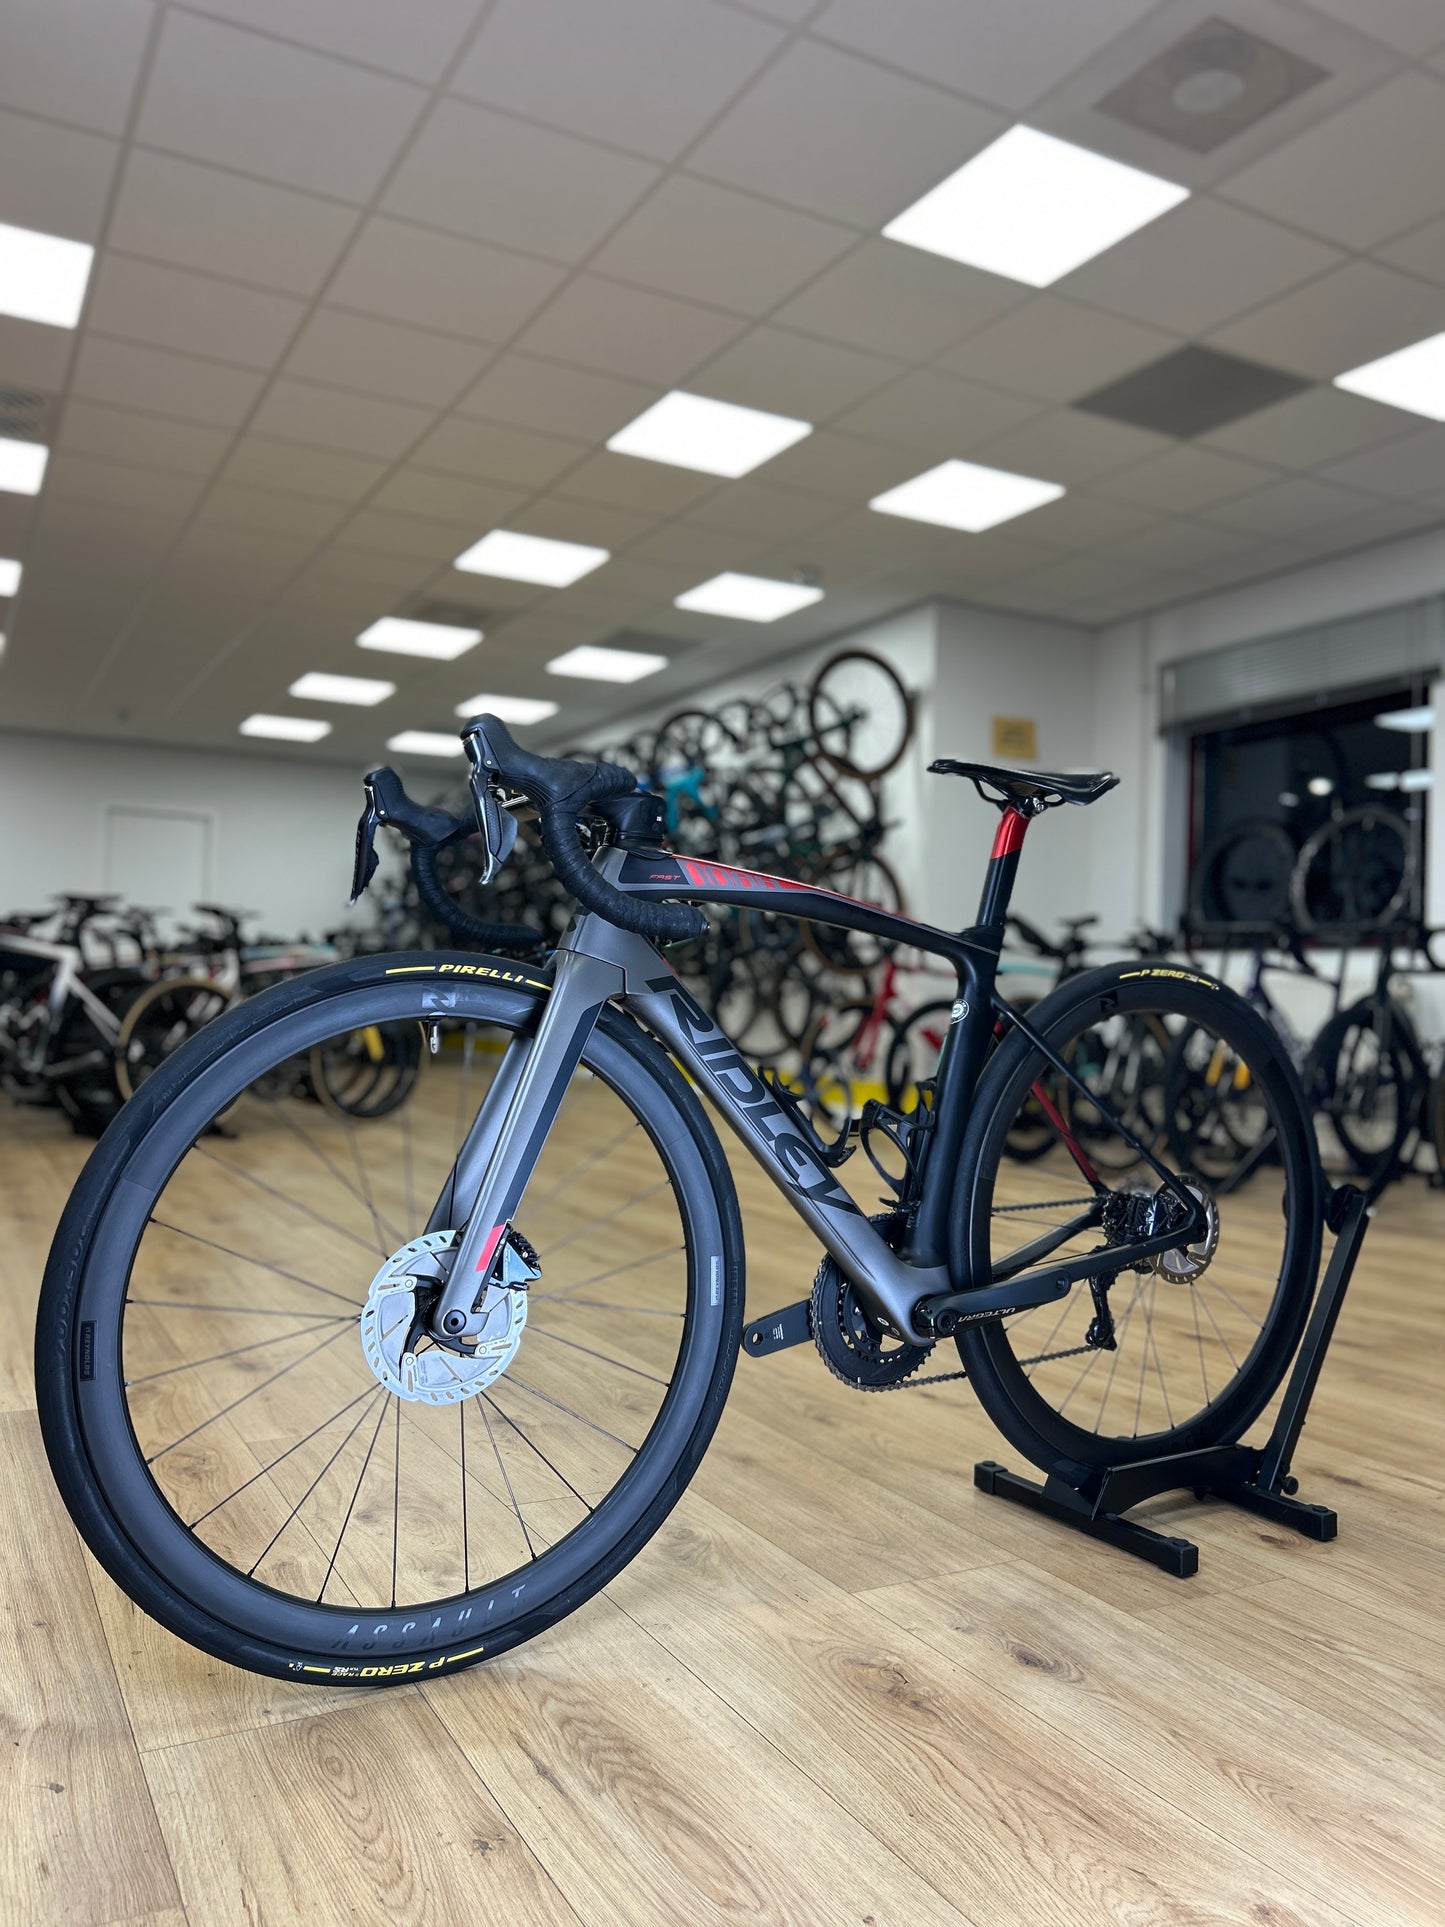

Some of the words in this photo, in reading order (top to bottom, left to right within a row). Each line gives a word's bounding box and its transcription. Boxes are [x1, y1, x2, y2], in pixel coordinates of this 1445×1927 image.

[648, 873, 682, 882] FAST
[438, 964, 524, 983] PIRELLI
[1140, 969, 1151, 977] P
[1151, 968, 1186, 979] ZERO
[644, 975, 864, 1217] RIDLEY
[957, 1307, 1017, 1323] ULTEGRA
[83, 1333, 92, 1376] REYNOLDS
[359, 1660, 426, 1678] ZERO
[428, 1656, 446, 1669] P
